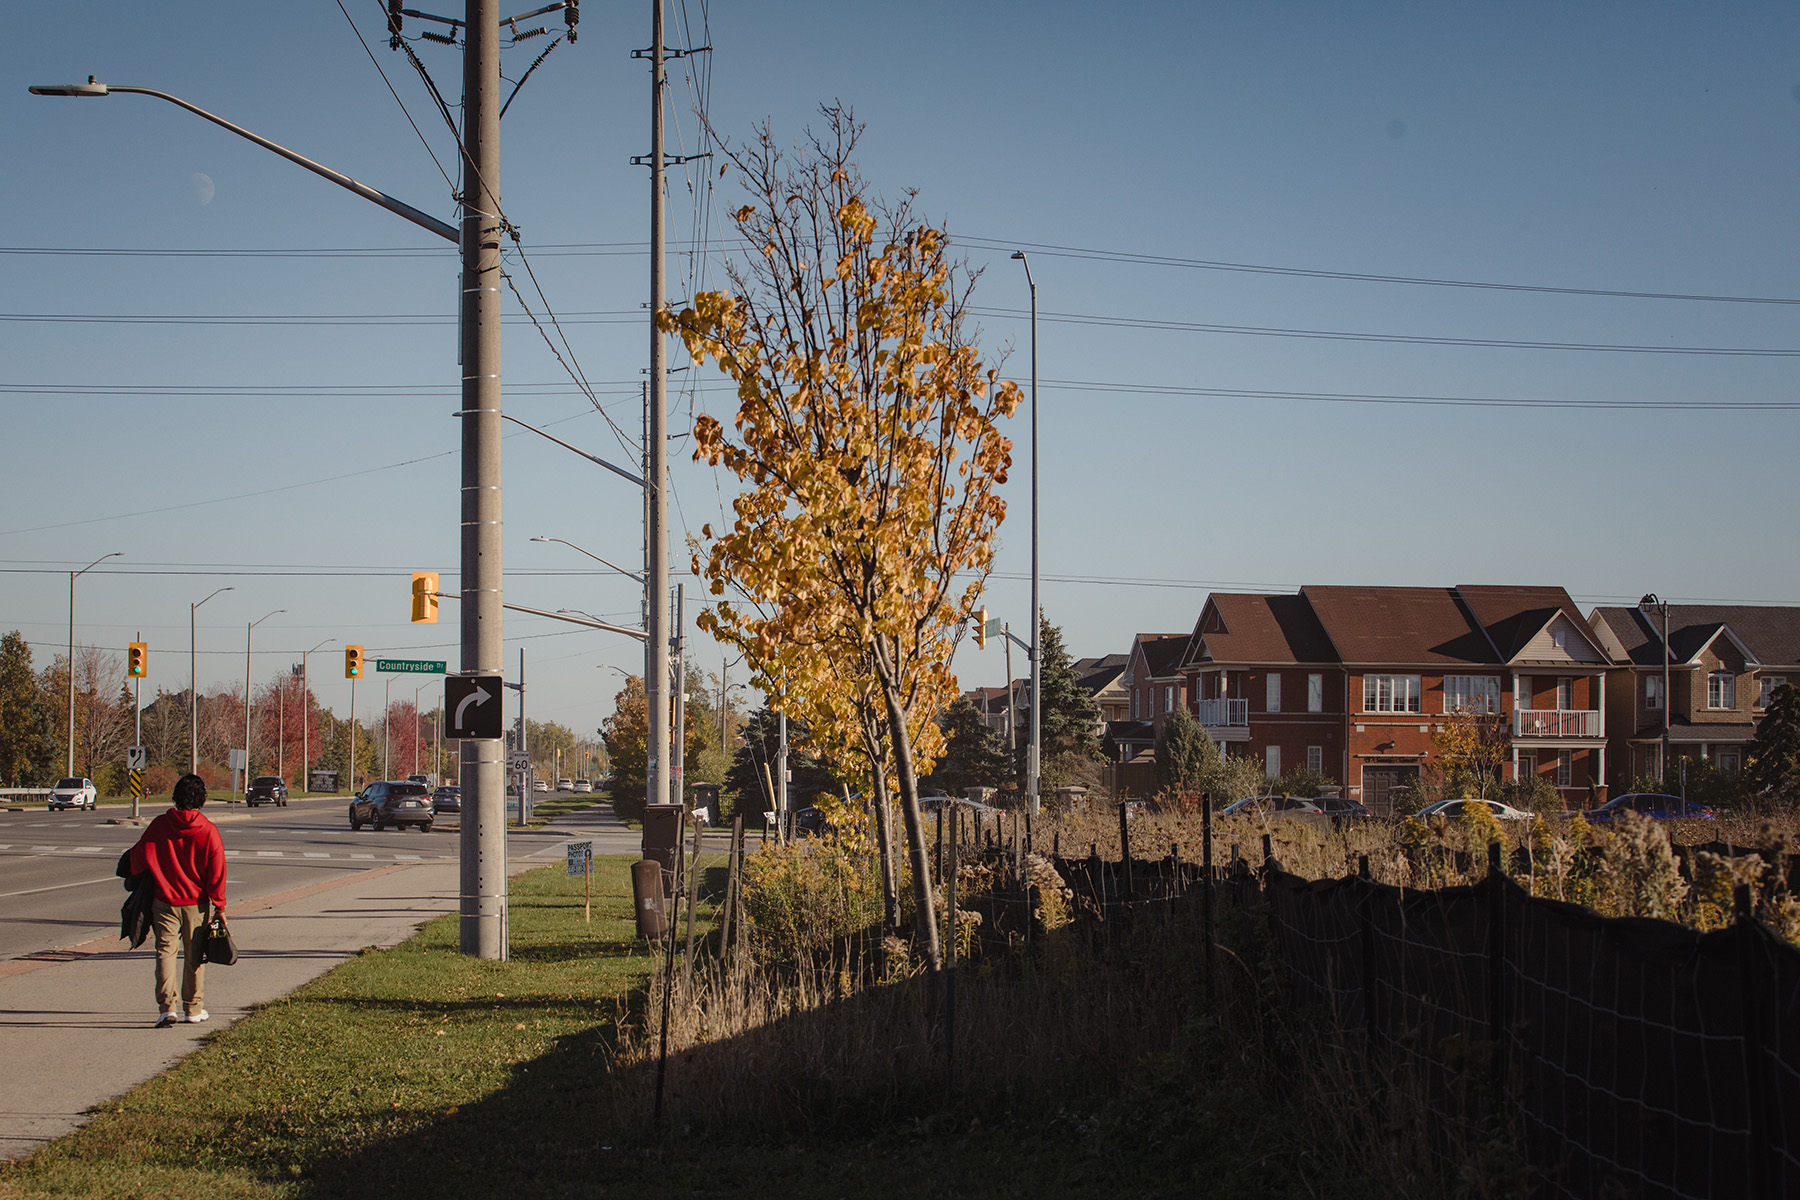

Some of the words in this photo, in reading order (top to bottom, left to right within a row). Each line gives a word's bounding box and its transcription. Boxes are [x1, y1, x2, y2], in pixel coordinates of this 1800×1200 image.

[379, 661, 434, 671] Countryside
[515, 760, 528, 770] 60
[568, 841, 592, 851] PASSPORT
